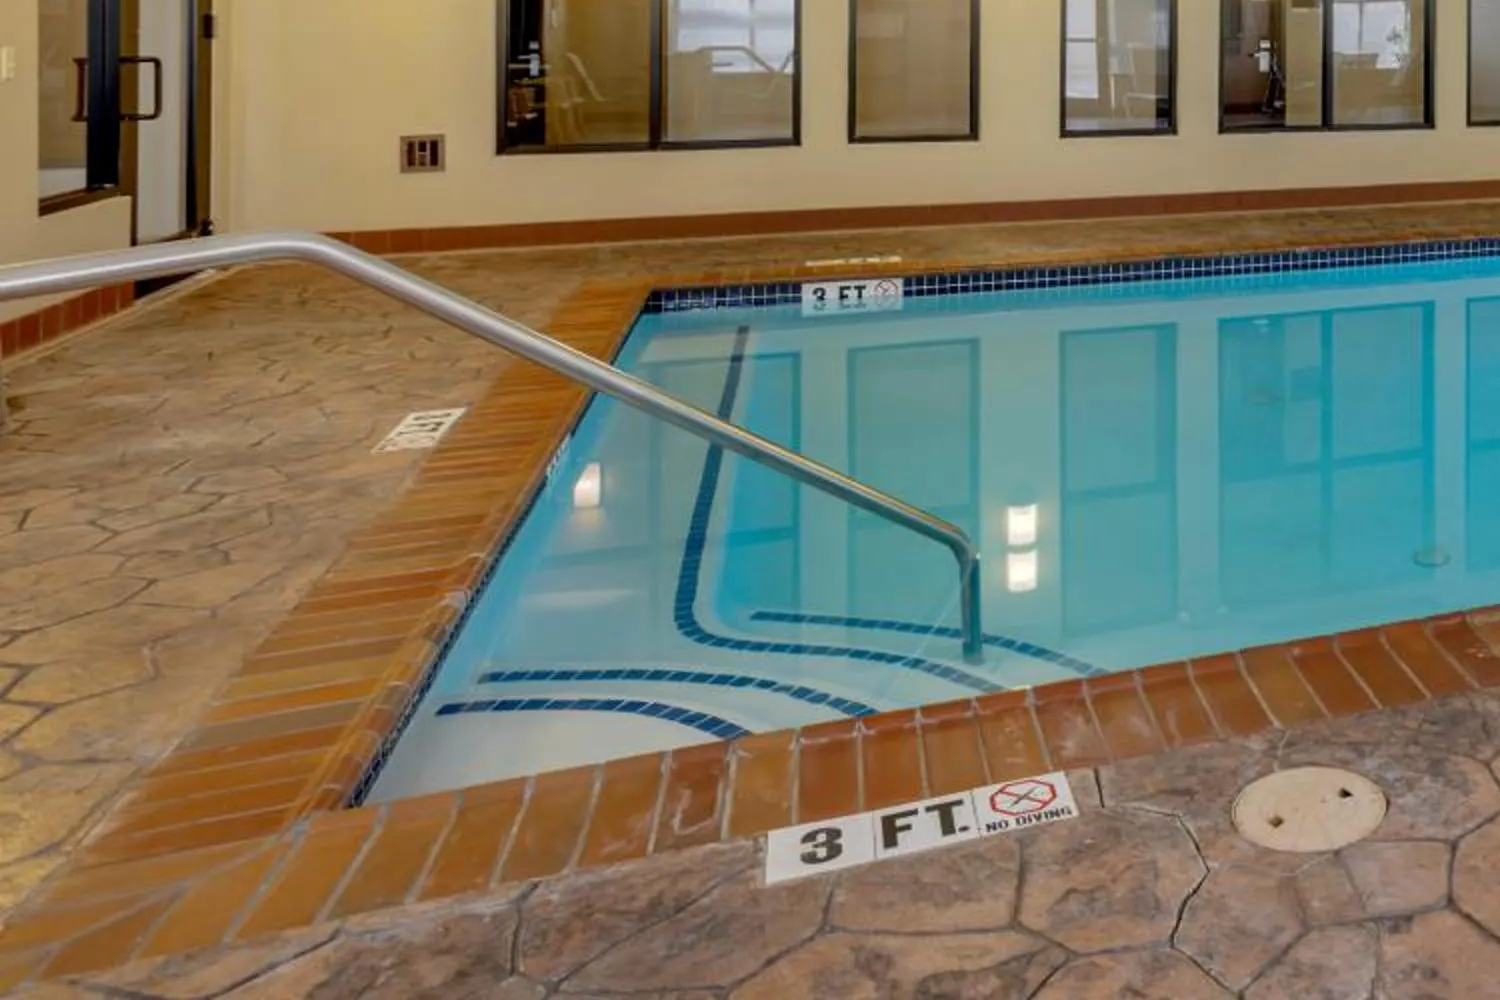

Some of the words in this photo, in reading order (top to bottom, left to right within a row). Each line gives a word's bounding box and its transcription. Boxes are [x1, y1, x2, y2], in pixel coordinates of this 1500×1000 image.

[800, 827, 844, 864] 3
[881, 799, 971, 849] FT.
[985, 819, 1009, 833] NO
[1015, 806, 1073, 825] DIVING
